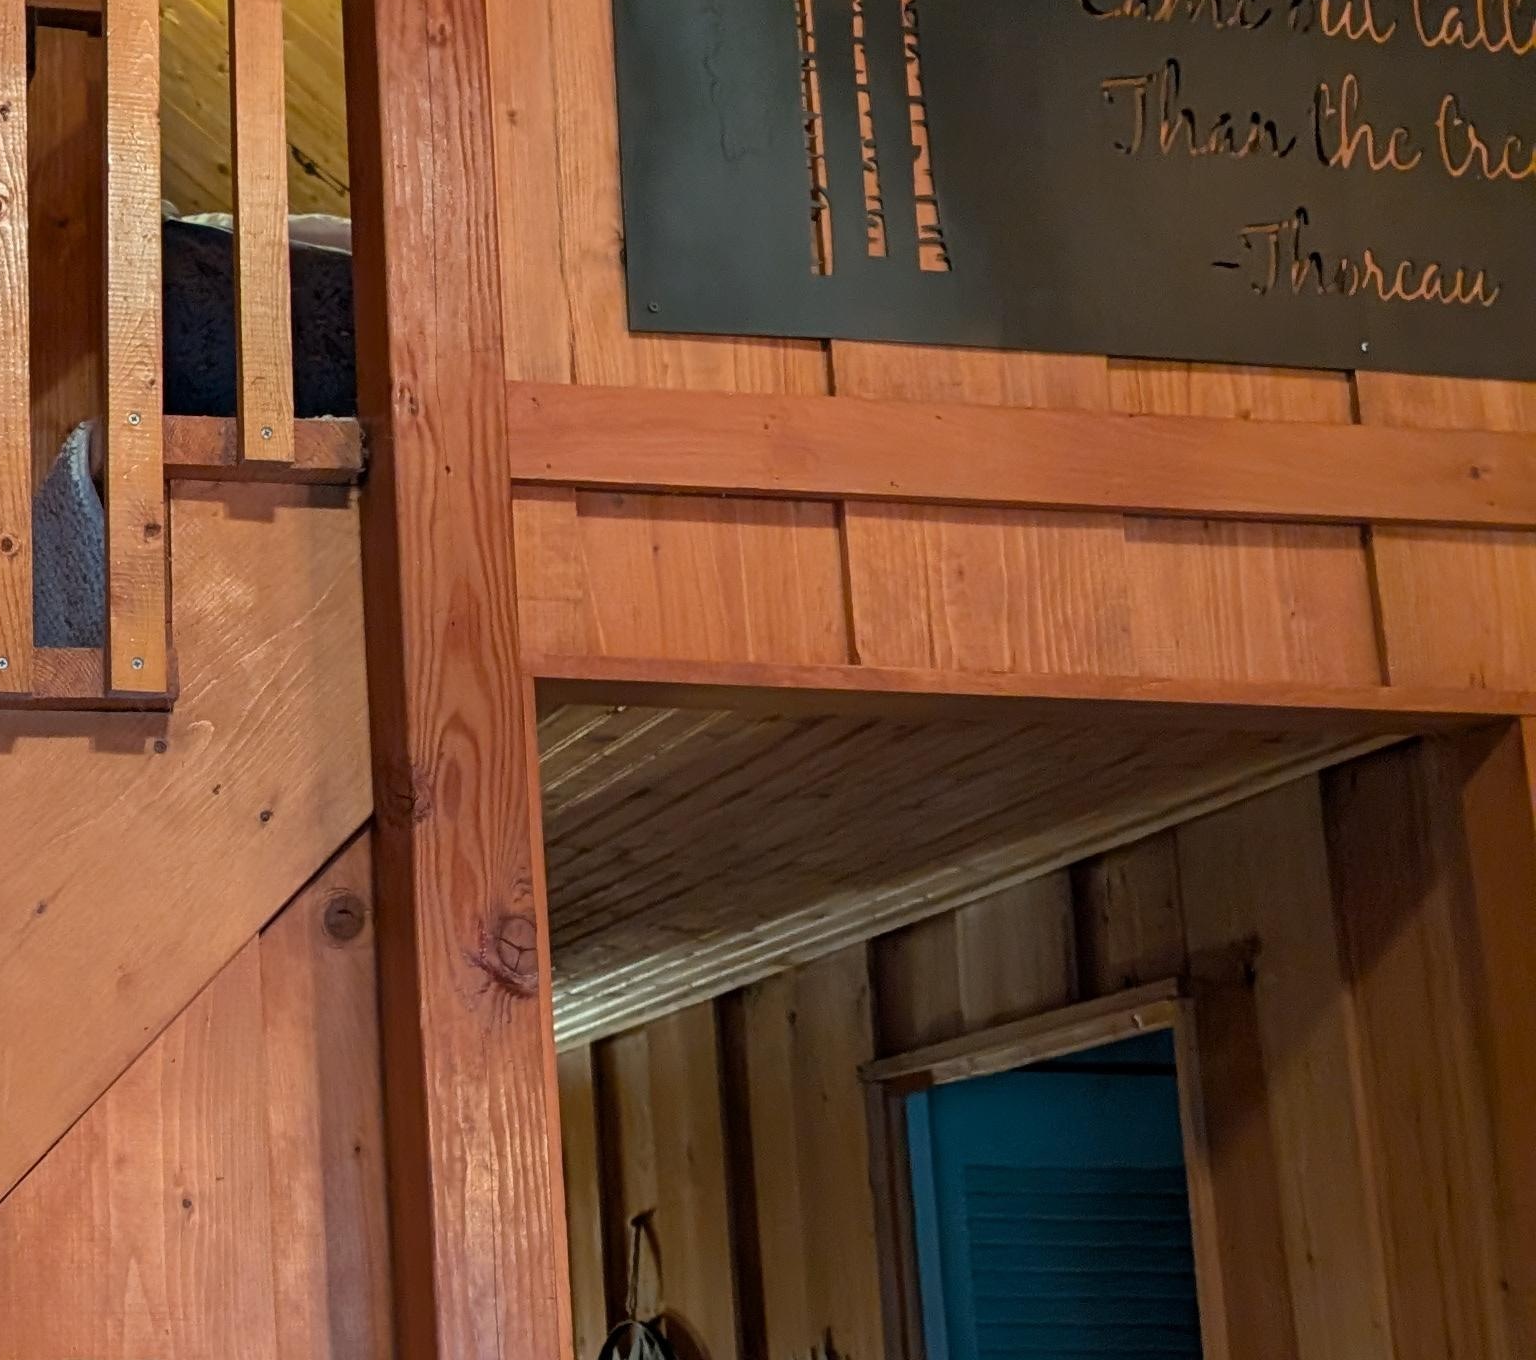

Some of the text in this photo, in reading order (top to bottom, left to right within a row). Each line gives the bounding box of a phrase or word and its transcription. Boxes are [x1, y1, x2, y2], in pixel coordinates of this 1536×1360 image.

[1101, 57, 1536, 180] Than the tre
